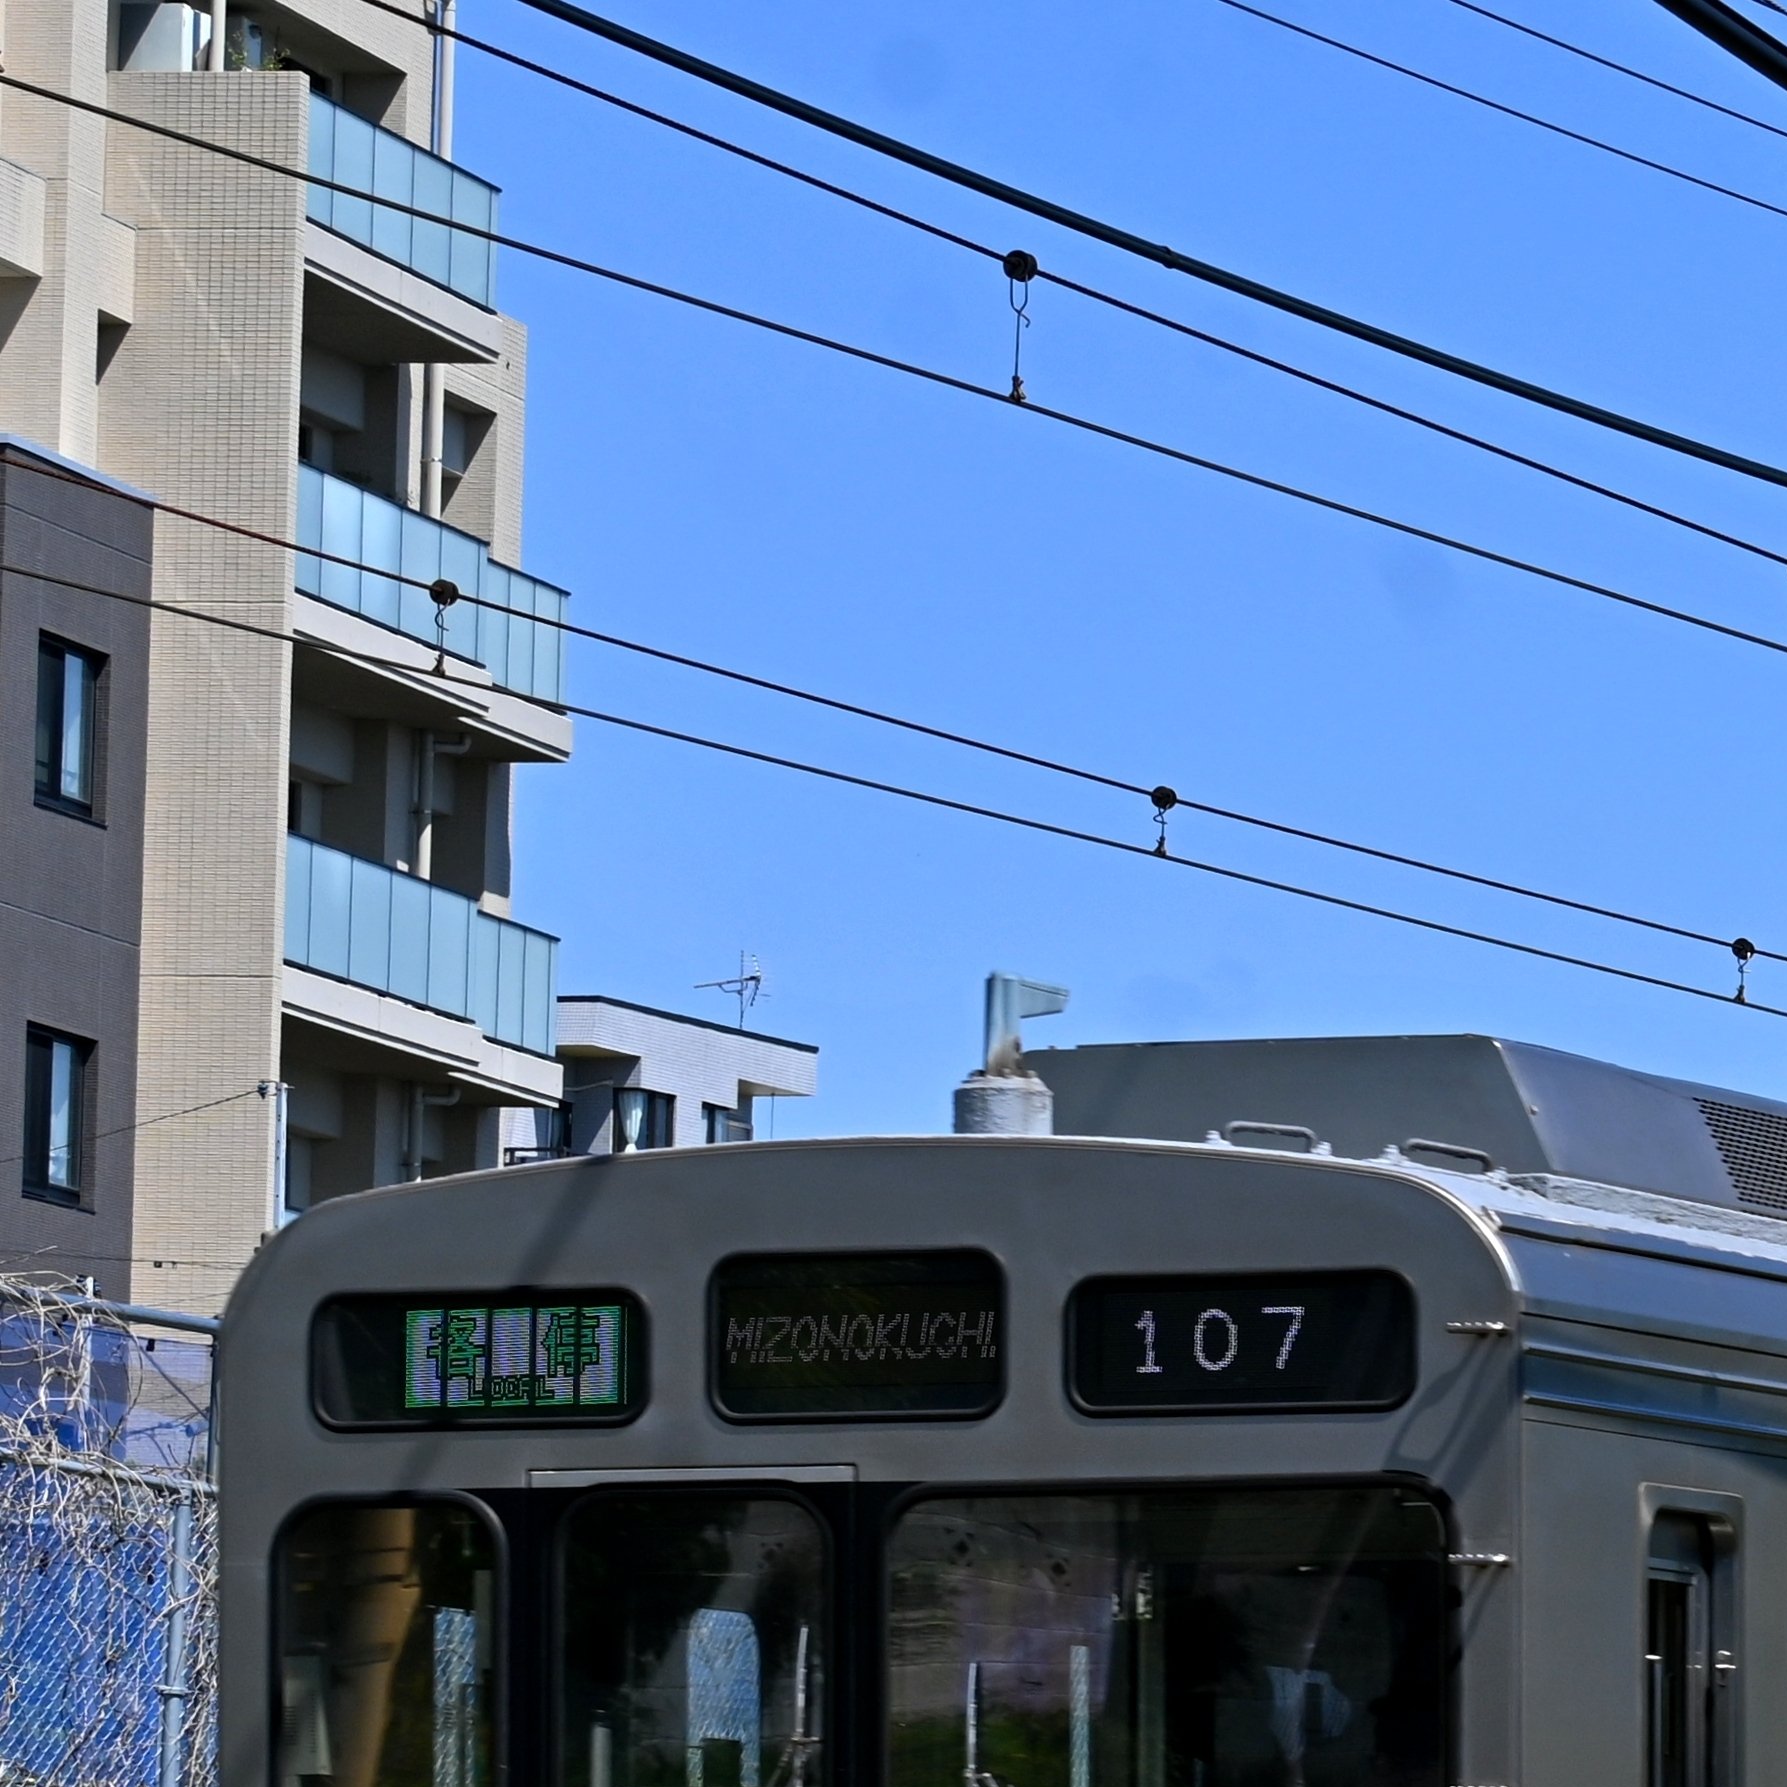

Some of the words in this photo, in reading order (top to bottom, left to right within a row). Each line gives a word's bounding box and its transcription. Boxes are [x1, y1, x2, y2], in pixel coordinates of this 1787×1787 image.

[727, 1311, 996, 1364] MIZONOKUCHI
[1135, 1306, 1304, 1373] 107
[469, 1375, 553, 1400] LOCAL
